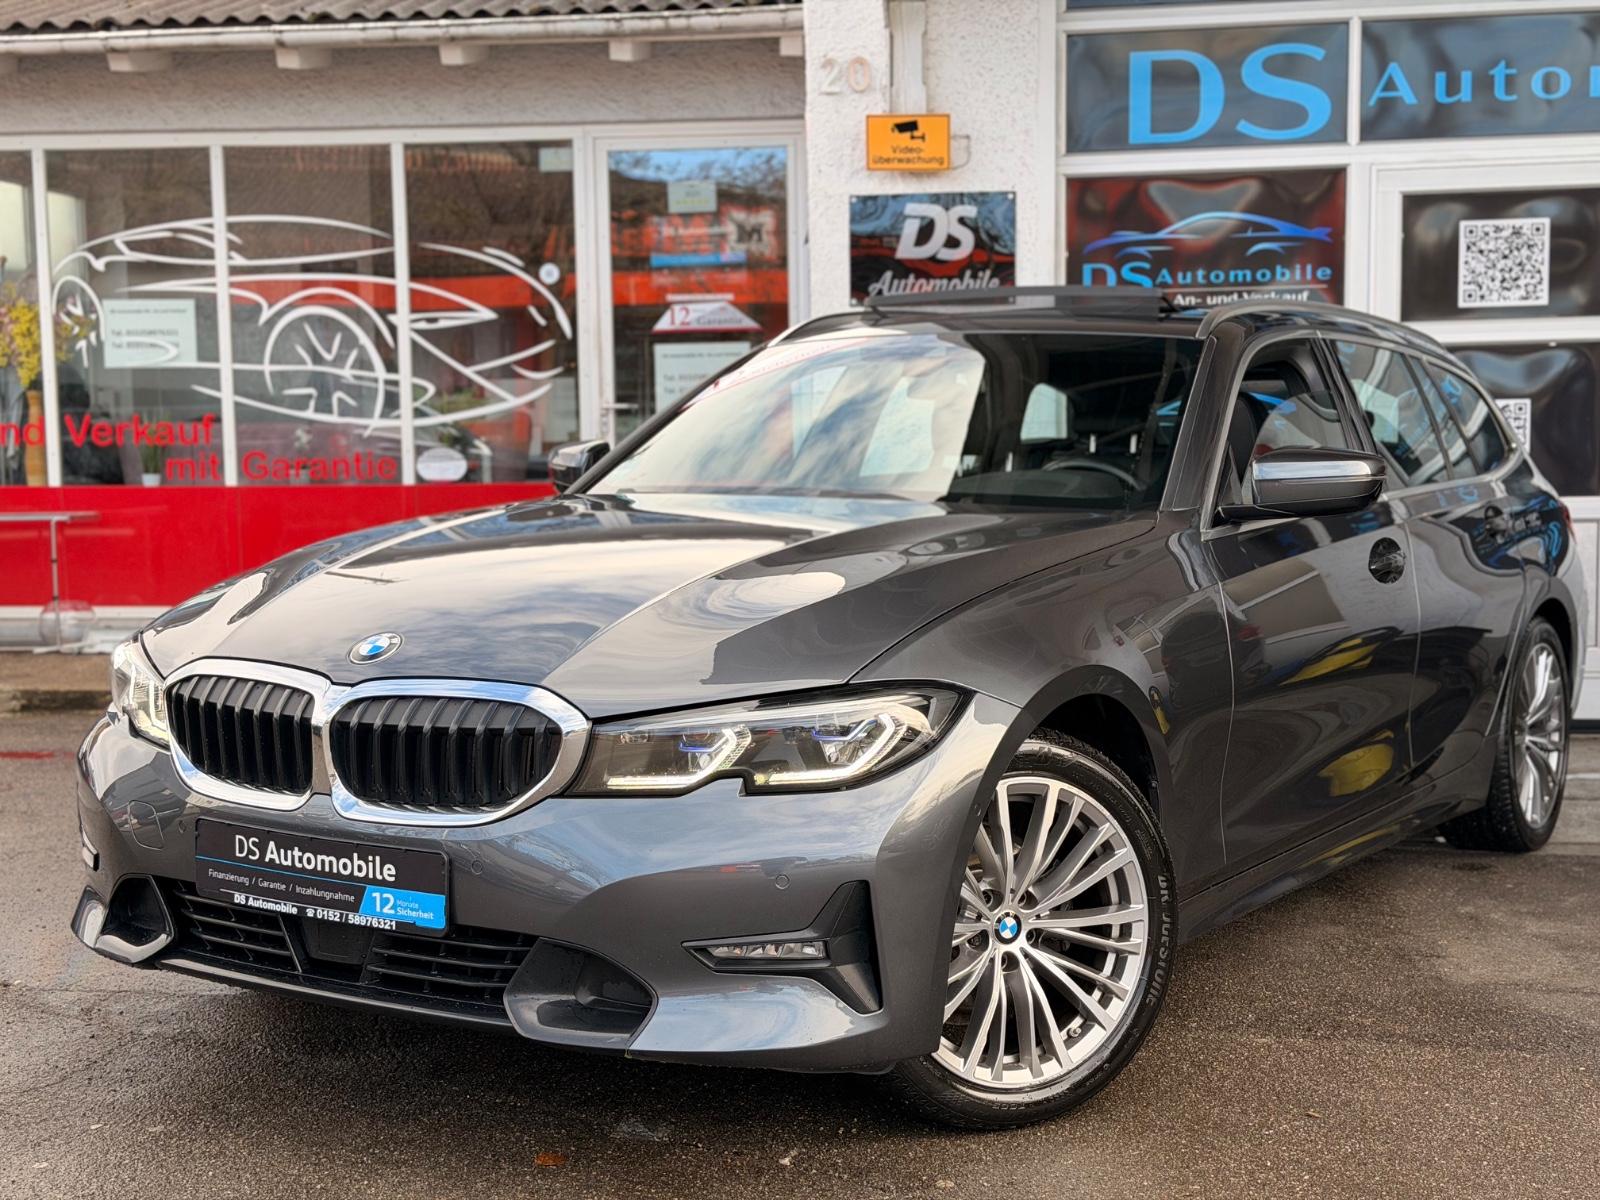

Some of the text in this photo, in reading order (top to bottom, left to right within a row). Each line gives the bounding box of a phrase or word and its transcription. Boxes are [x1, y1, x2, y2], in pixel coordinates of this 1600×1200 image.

[819, 56, 872, 95] 20
[1128, 42, 1333, 145] DS
[894, 202, 978, 262] DS
[867, 268, 1001, 297] Automobile
[1155, 263, 1332, 286] Automobile
[668, 305, 691, 327] 12
[1173, 293, 1203, 306] An-
[63, 411, 216, 448] Verkauf
[165, 450, 398, 481] mit Garantie
[235, 834, 397, 882] DS Automobile
[208, 868, 250, 887] Finanzierung
[257, 878, 287, 892] Garantie
[295, 884, 356, 903] Inzahlungnahme
[233, 893, 246, 905] DS
[247, 896, 299, 914] Automobile
[316, 909, 341, 923] 0152
[347, 914, 397, 930] 58976321
[371, 892, 396, 914] 12
[396, 906, 435, 920] Sicherheit
